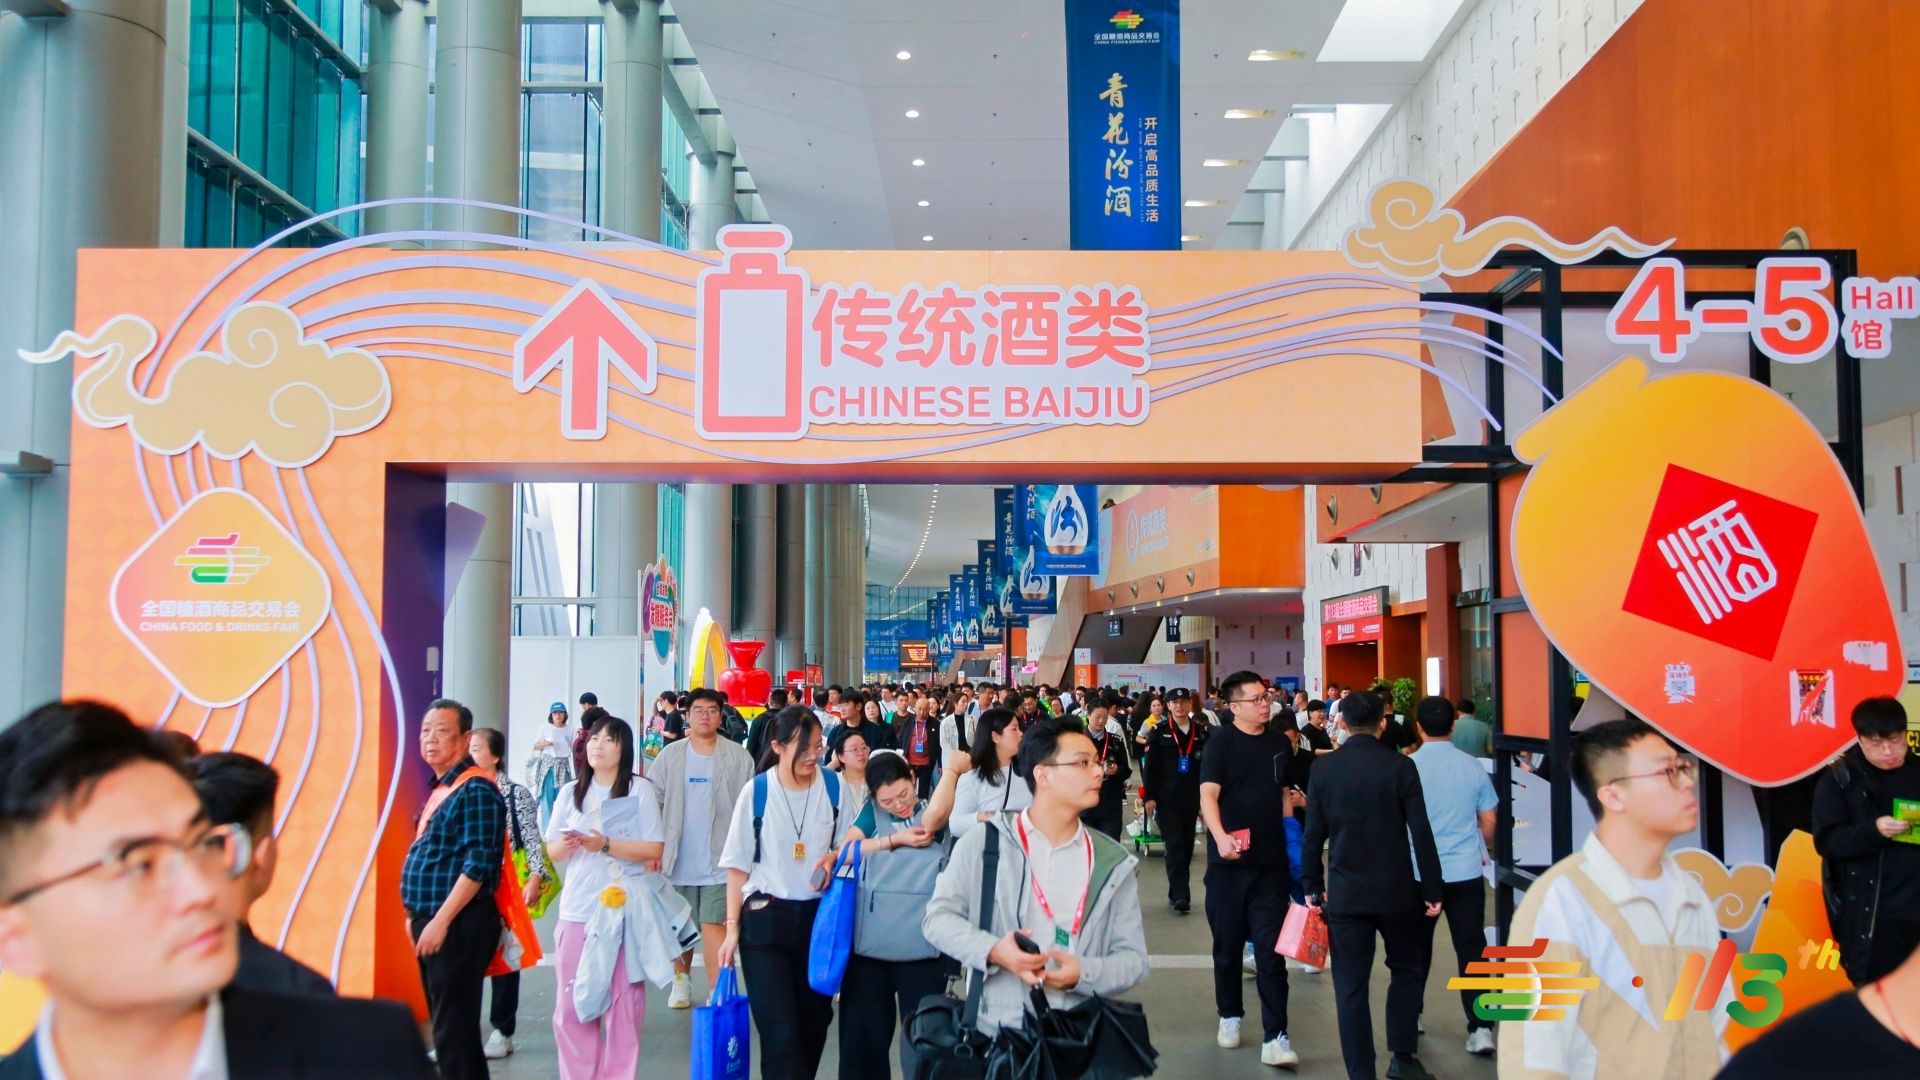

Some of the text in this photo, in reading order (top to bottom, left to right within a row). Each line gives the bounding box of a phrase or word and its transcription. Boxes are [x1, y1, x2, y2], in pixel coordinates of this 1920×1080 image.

[1099, 72, 1134, 217] 青花汾酒
[1144, 117, 1159, 222] 开启高品质生活
[1851, 286, 1913, 310] Hall
[811, 287, 1146, 368] 传统酒类
[1851, 320, 1883, 350] 馆
[809, 386, 1143, 418] CHINESE BAIJIU
[1657, 499, 1777, 625] 酒
[140, 600, 301, 618] 全国糖酒商品交易会
[140, 622, 300, 632] CHINA FOOD & DRINKS FAIR
